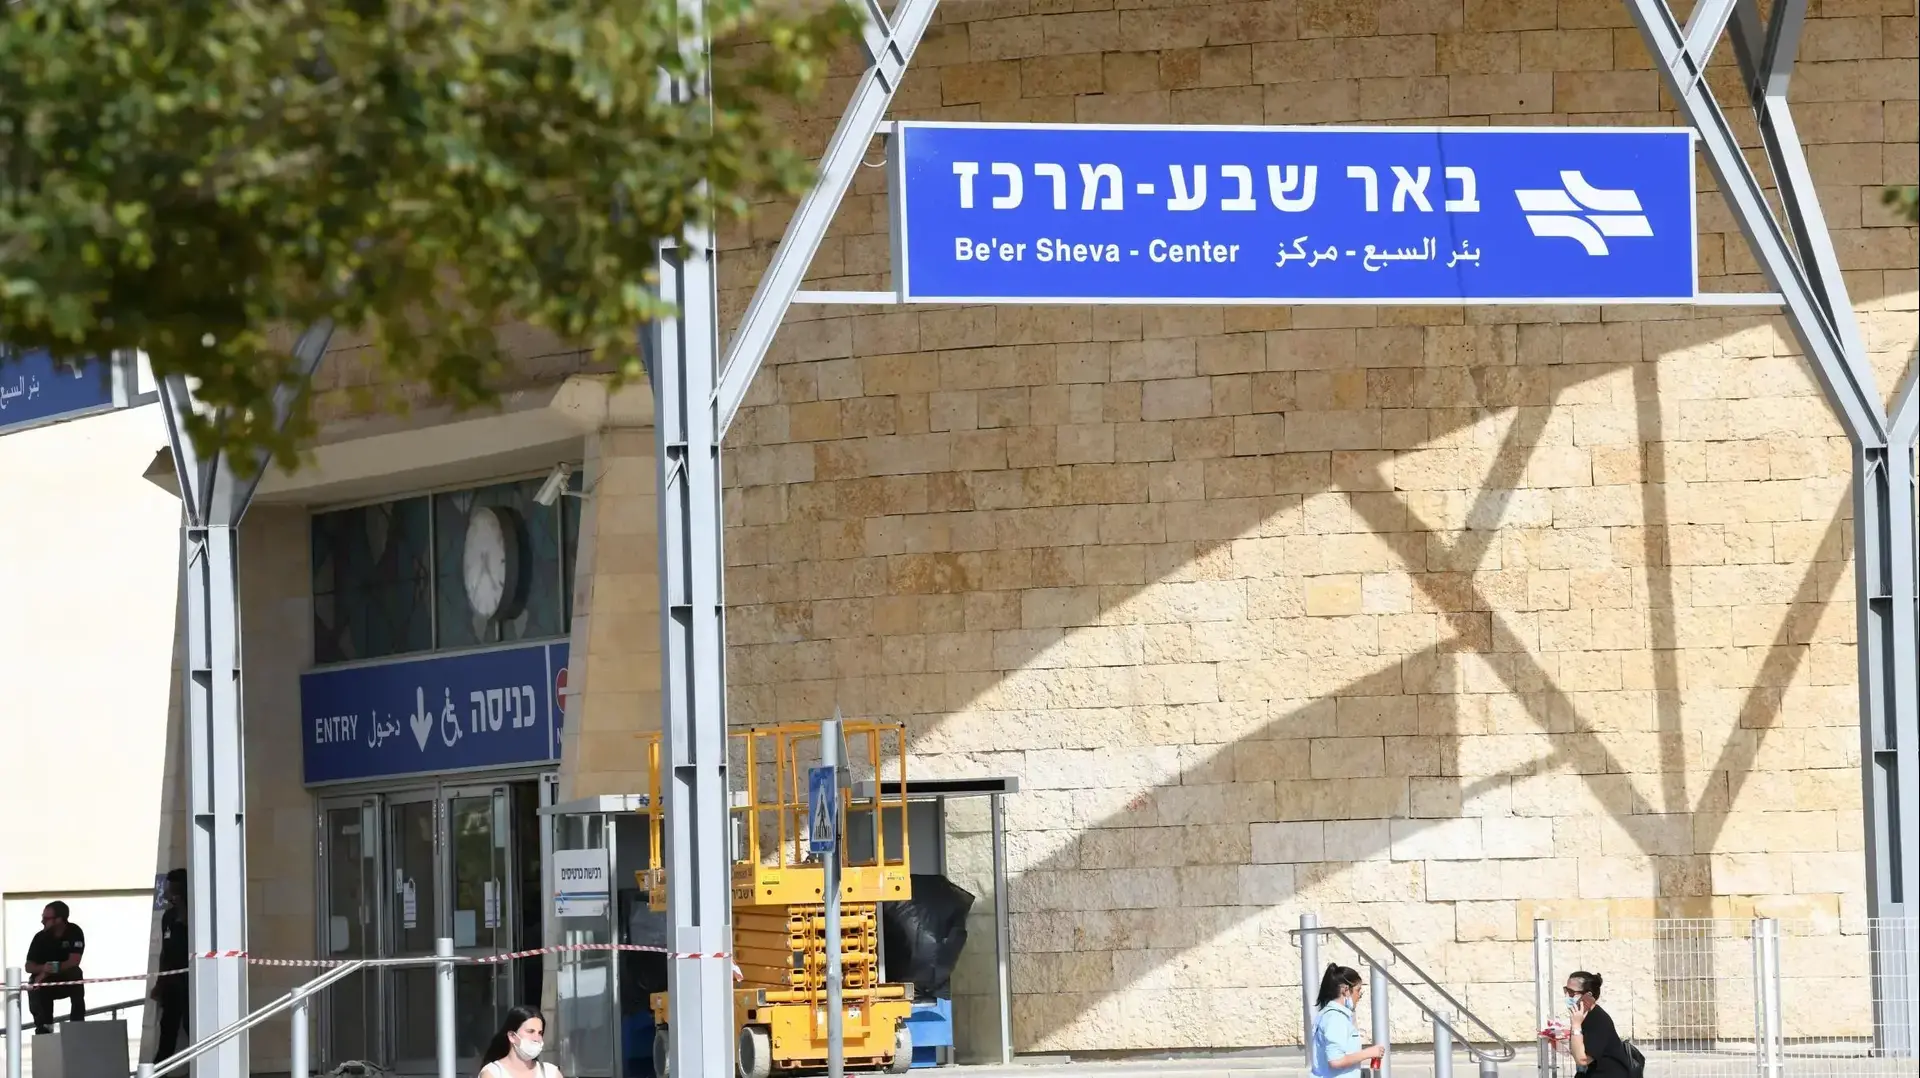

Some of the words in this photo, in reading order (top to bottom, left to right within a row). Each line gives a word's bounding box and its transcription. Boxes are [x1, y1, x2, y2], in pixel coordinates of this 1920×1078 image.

[1347, 165, 1480, 213] באר
[955, 237, 1027, 262] Be'er
[1036, 237, 1120, 263] Sheva
[1148, 238, 1240, 263] Center
[1275, 235, 1338, 268] مركز
[1363, 236, 1436, 272] السبع
[1446, 238, 1481, 269] بئر
[470, 685, 536, 733] כניסה
[315, 715, 359, 744] ENTRY
[367, 710, 401, 749] دخول
